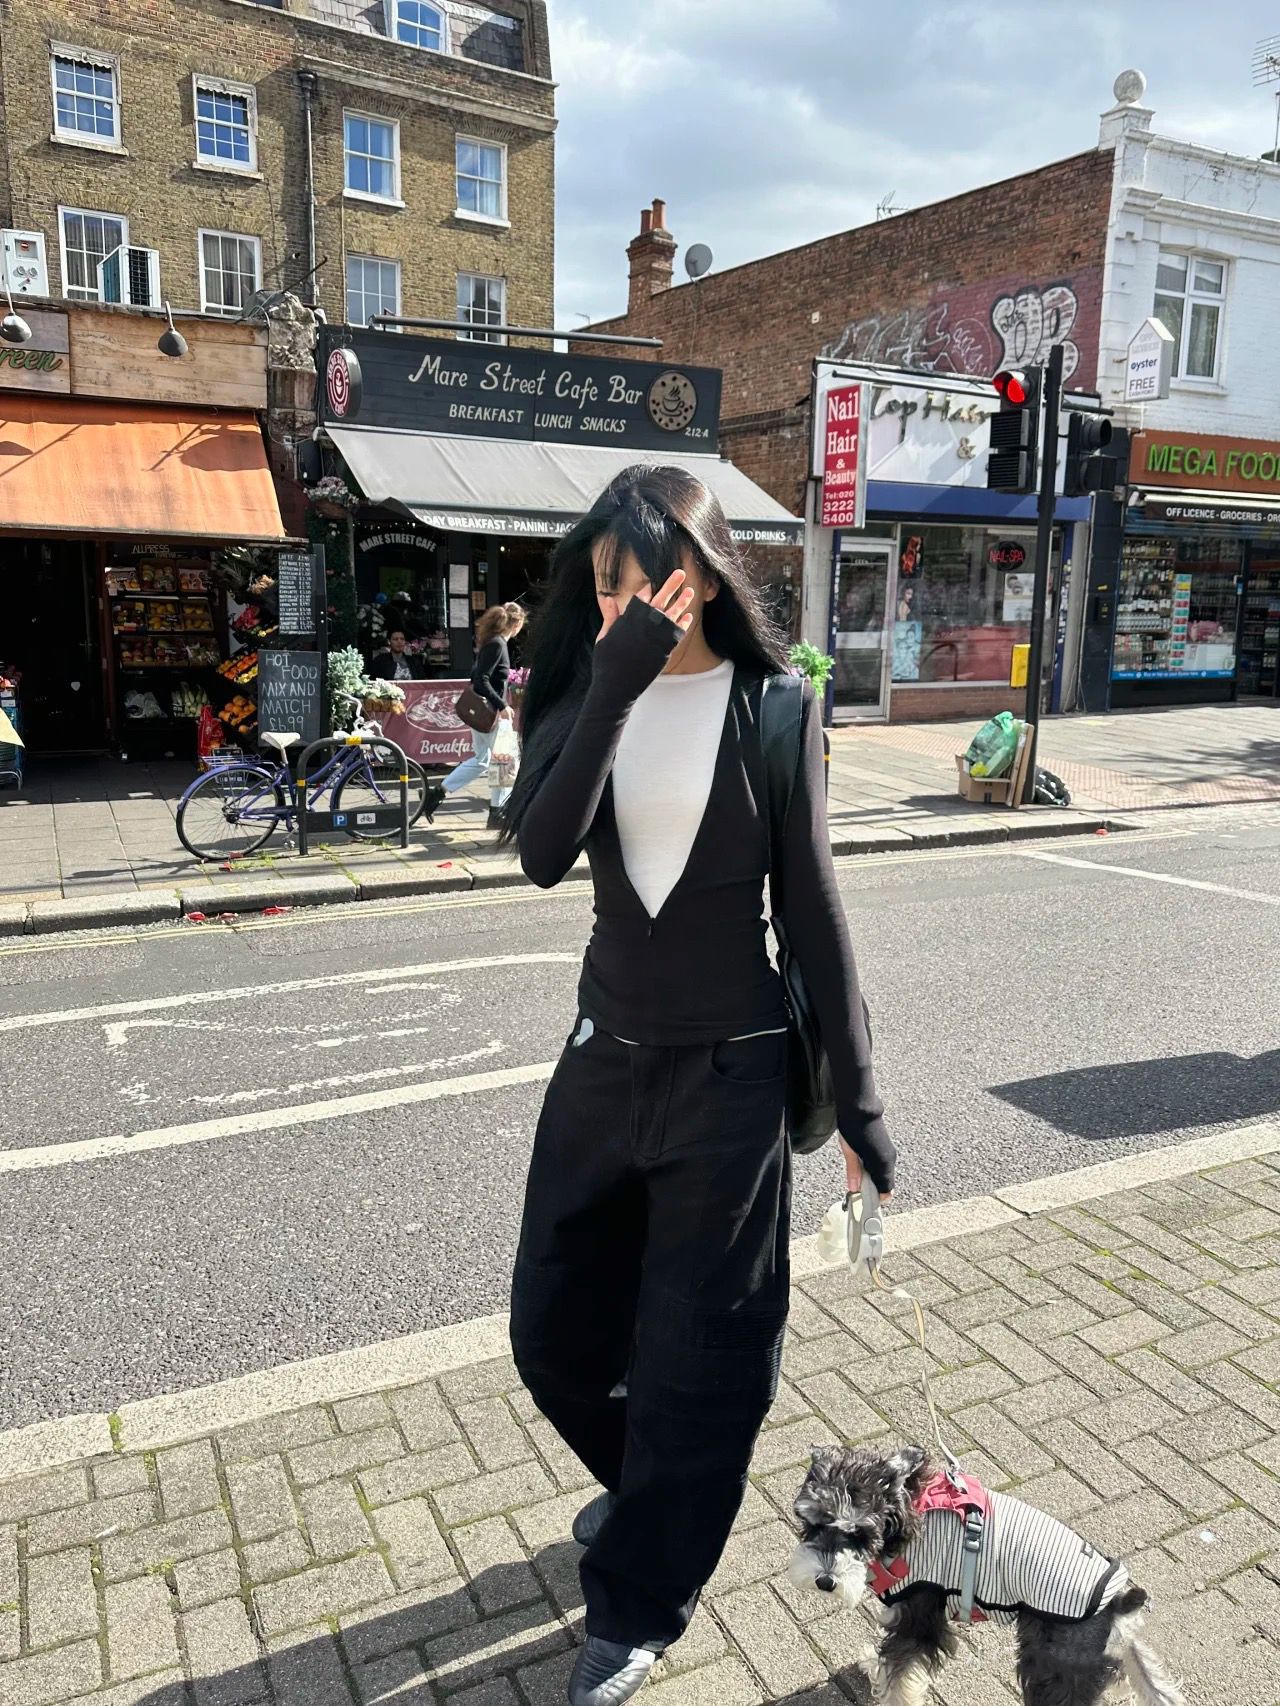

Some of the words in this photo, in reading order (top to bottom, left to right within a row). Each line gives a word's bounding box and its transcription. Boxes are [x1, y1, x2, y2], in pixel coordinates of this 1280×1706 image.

[1130, 358, 1158, 372] oyster
[408, 354, 468, 387] Mare
[480, 362, 546, 396] Street
[555, 371, 599, 409] Cafe
[607, 375, 643, 405] Bar
[1129, 376, 1155, 391] FREE
[827, 391, 859, 423] Nail
[870, 384, 918, 444] Top
[449, 404, 524, 423] BREAKFAST
[534, 412, 573, 429] LUNCH
[580, 416, 626, 433] SNACKS
[826, 429, 858, 456] Hair
[957, 436, 976, 460] &
[836, 458, 846, 469] &
[1147, 443, 1218, 476] MEGA
[1225, 450, 1280, 480] FOO
[825, 470, 857, 486] Beauty
[823, 500, 854, 512] 3222
[1166, 507, 1182, 517] OFF
[1183, 508, 1215, 519] LICENCE
[1220, 510, 1262, 521] GROCERIES
[423, 515, 446, 526] DAY
[449, 516, 506, 530] BREAKFAST
[514, 520, 549, 533] PANINI
[554, 522, 576, 533] JAC
[823, 512, 853, 525] 5400
[359, 534, 384, 552] MARE
[384, 532, 415, 545] STREET
[415, 536, 437, 552] CAFE
[730, 530, 754, 541] COLD
[755, 530, 786, 541] DRINKS
[265, 653, 291, 668] HOT
[281, 664, 317, 680] FOOD
[261, 681, 286, 697] MIX
[289, 681, 316, 697] AND
[261, 698, 311, 715] MATCH
[420, 738, 474, 757] Breakfa
[336, 815, 345, 826] P
